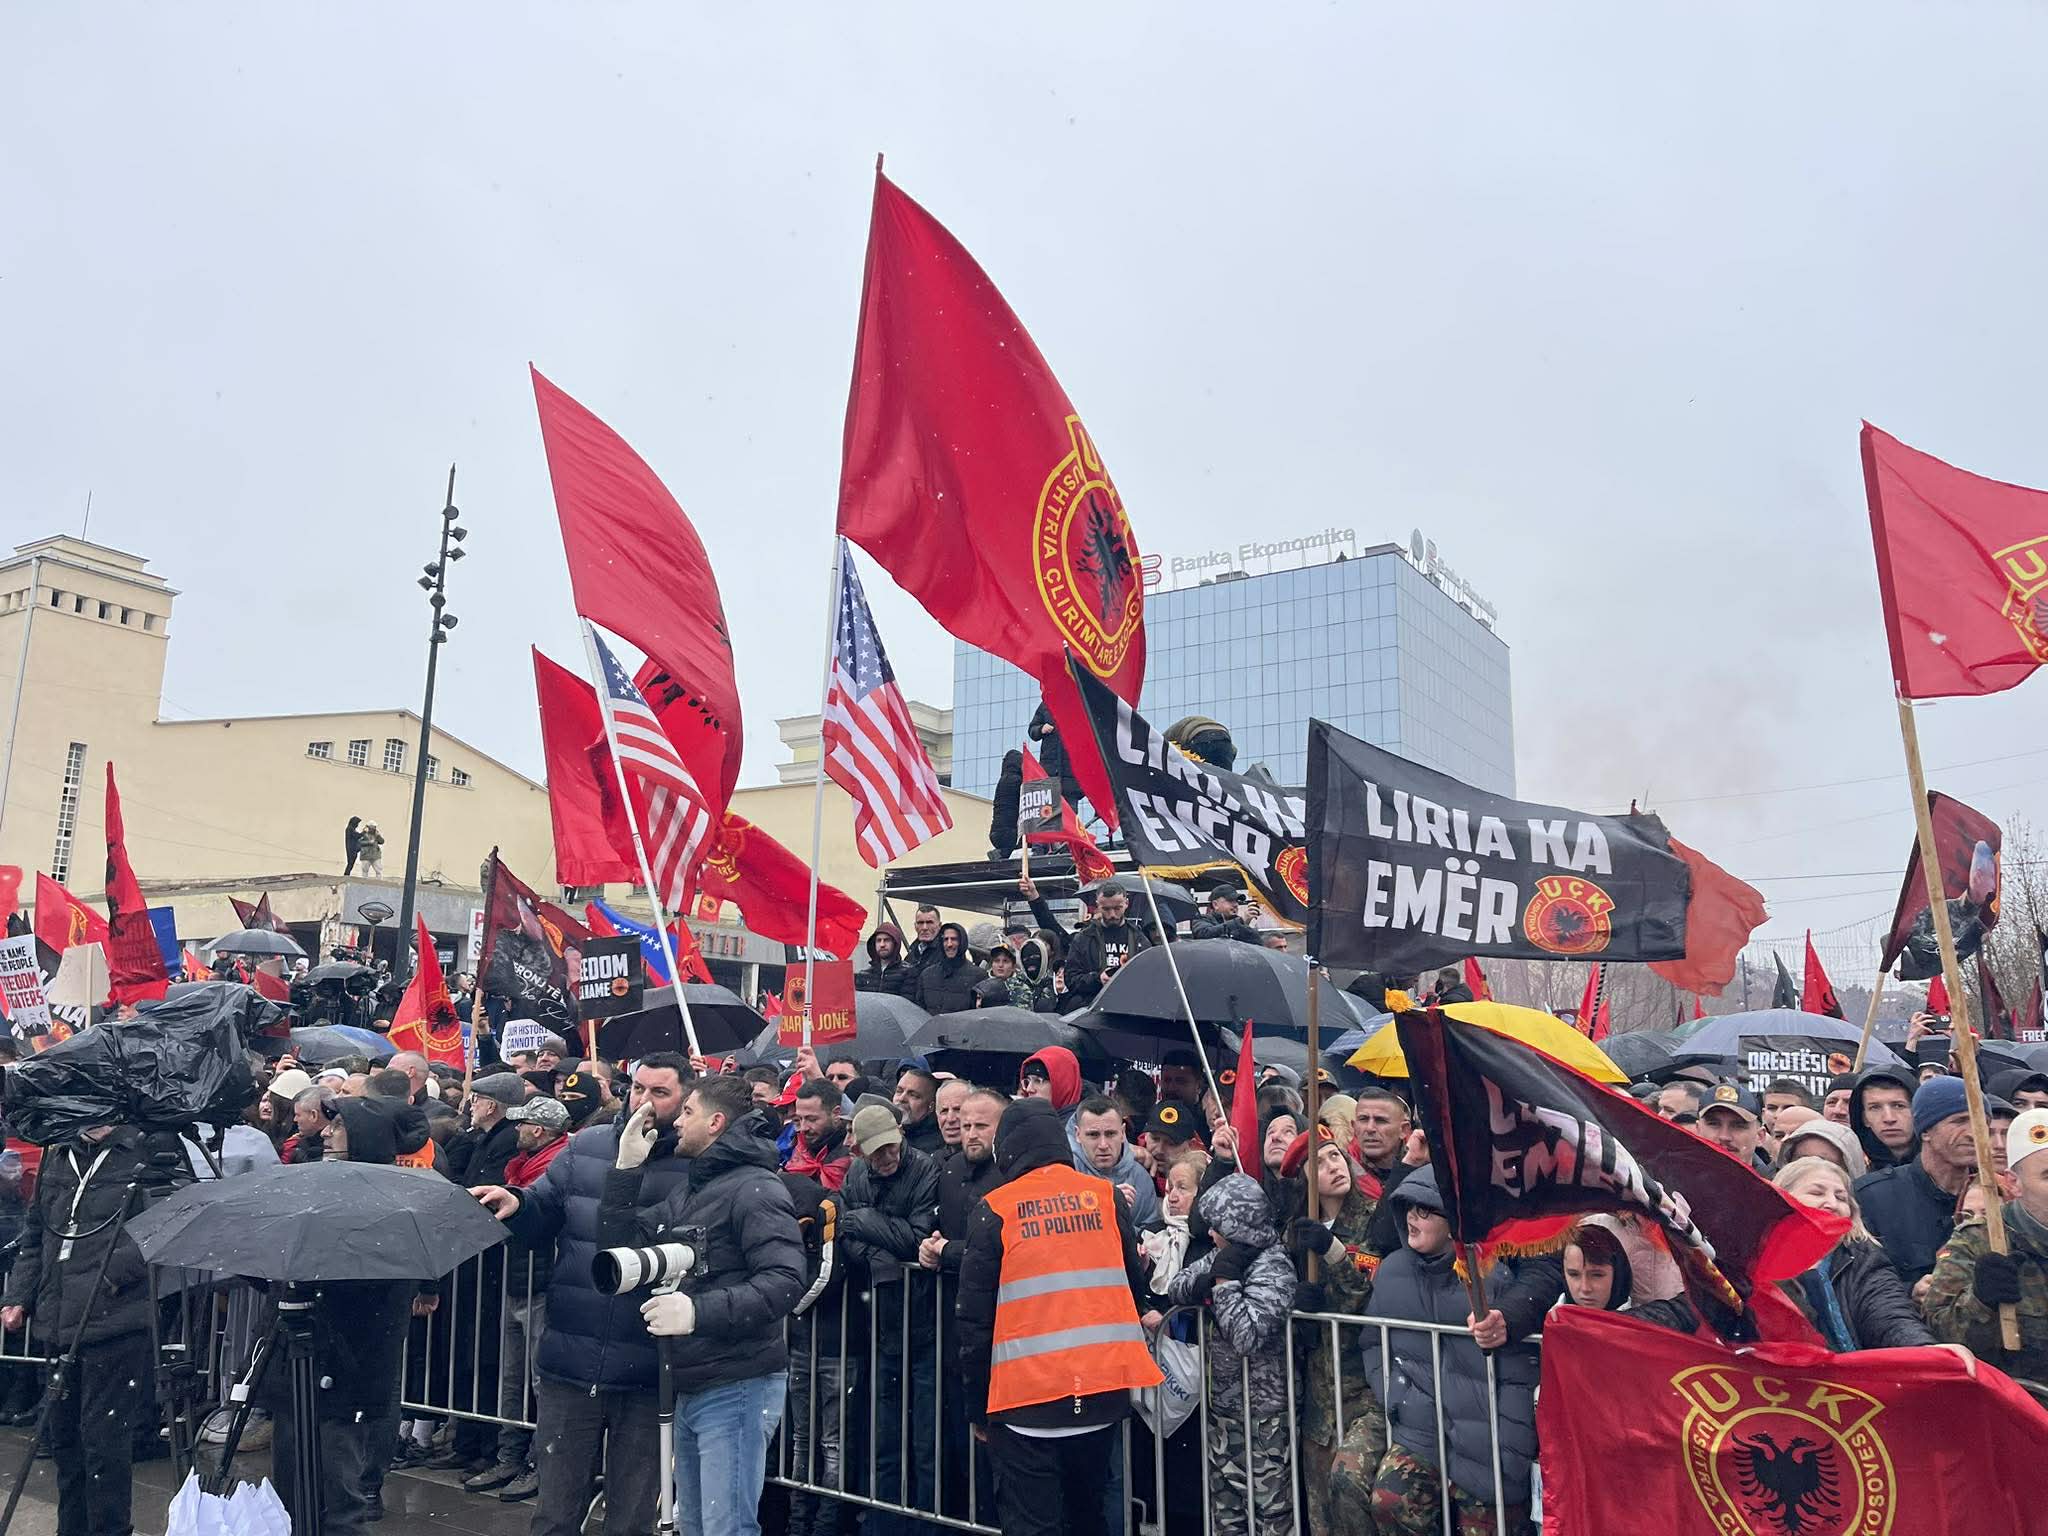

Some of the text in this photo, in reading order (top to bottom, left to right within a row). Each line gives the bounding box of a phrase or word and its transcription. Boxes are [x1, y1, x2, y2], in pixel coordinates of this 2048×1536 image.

[1171, 527, 1355, 574] Banka Ekonomike
[1363, 780, 1612, 875] LIRIA KA
[1363, 857, 1519, 944] EMËR
[1542, 879, 1609, 913] UÇK
[818, 1009, 850, 1031] JONË
[506, 1036, 535, 1049] CANNOT
[1748, 1048, 1827, 1074] DREJTËSI
[1017, 1191, 1081, 1219] DREJTËSI
[1021, 1208, 1103, 1239] JO POLITIKË
[1691, 1372, 1856, 1425] UÇK
[1693, 1420, 1720, 1507] USHTRIA
